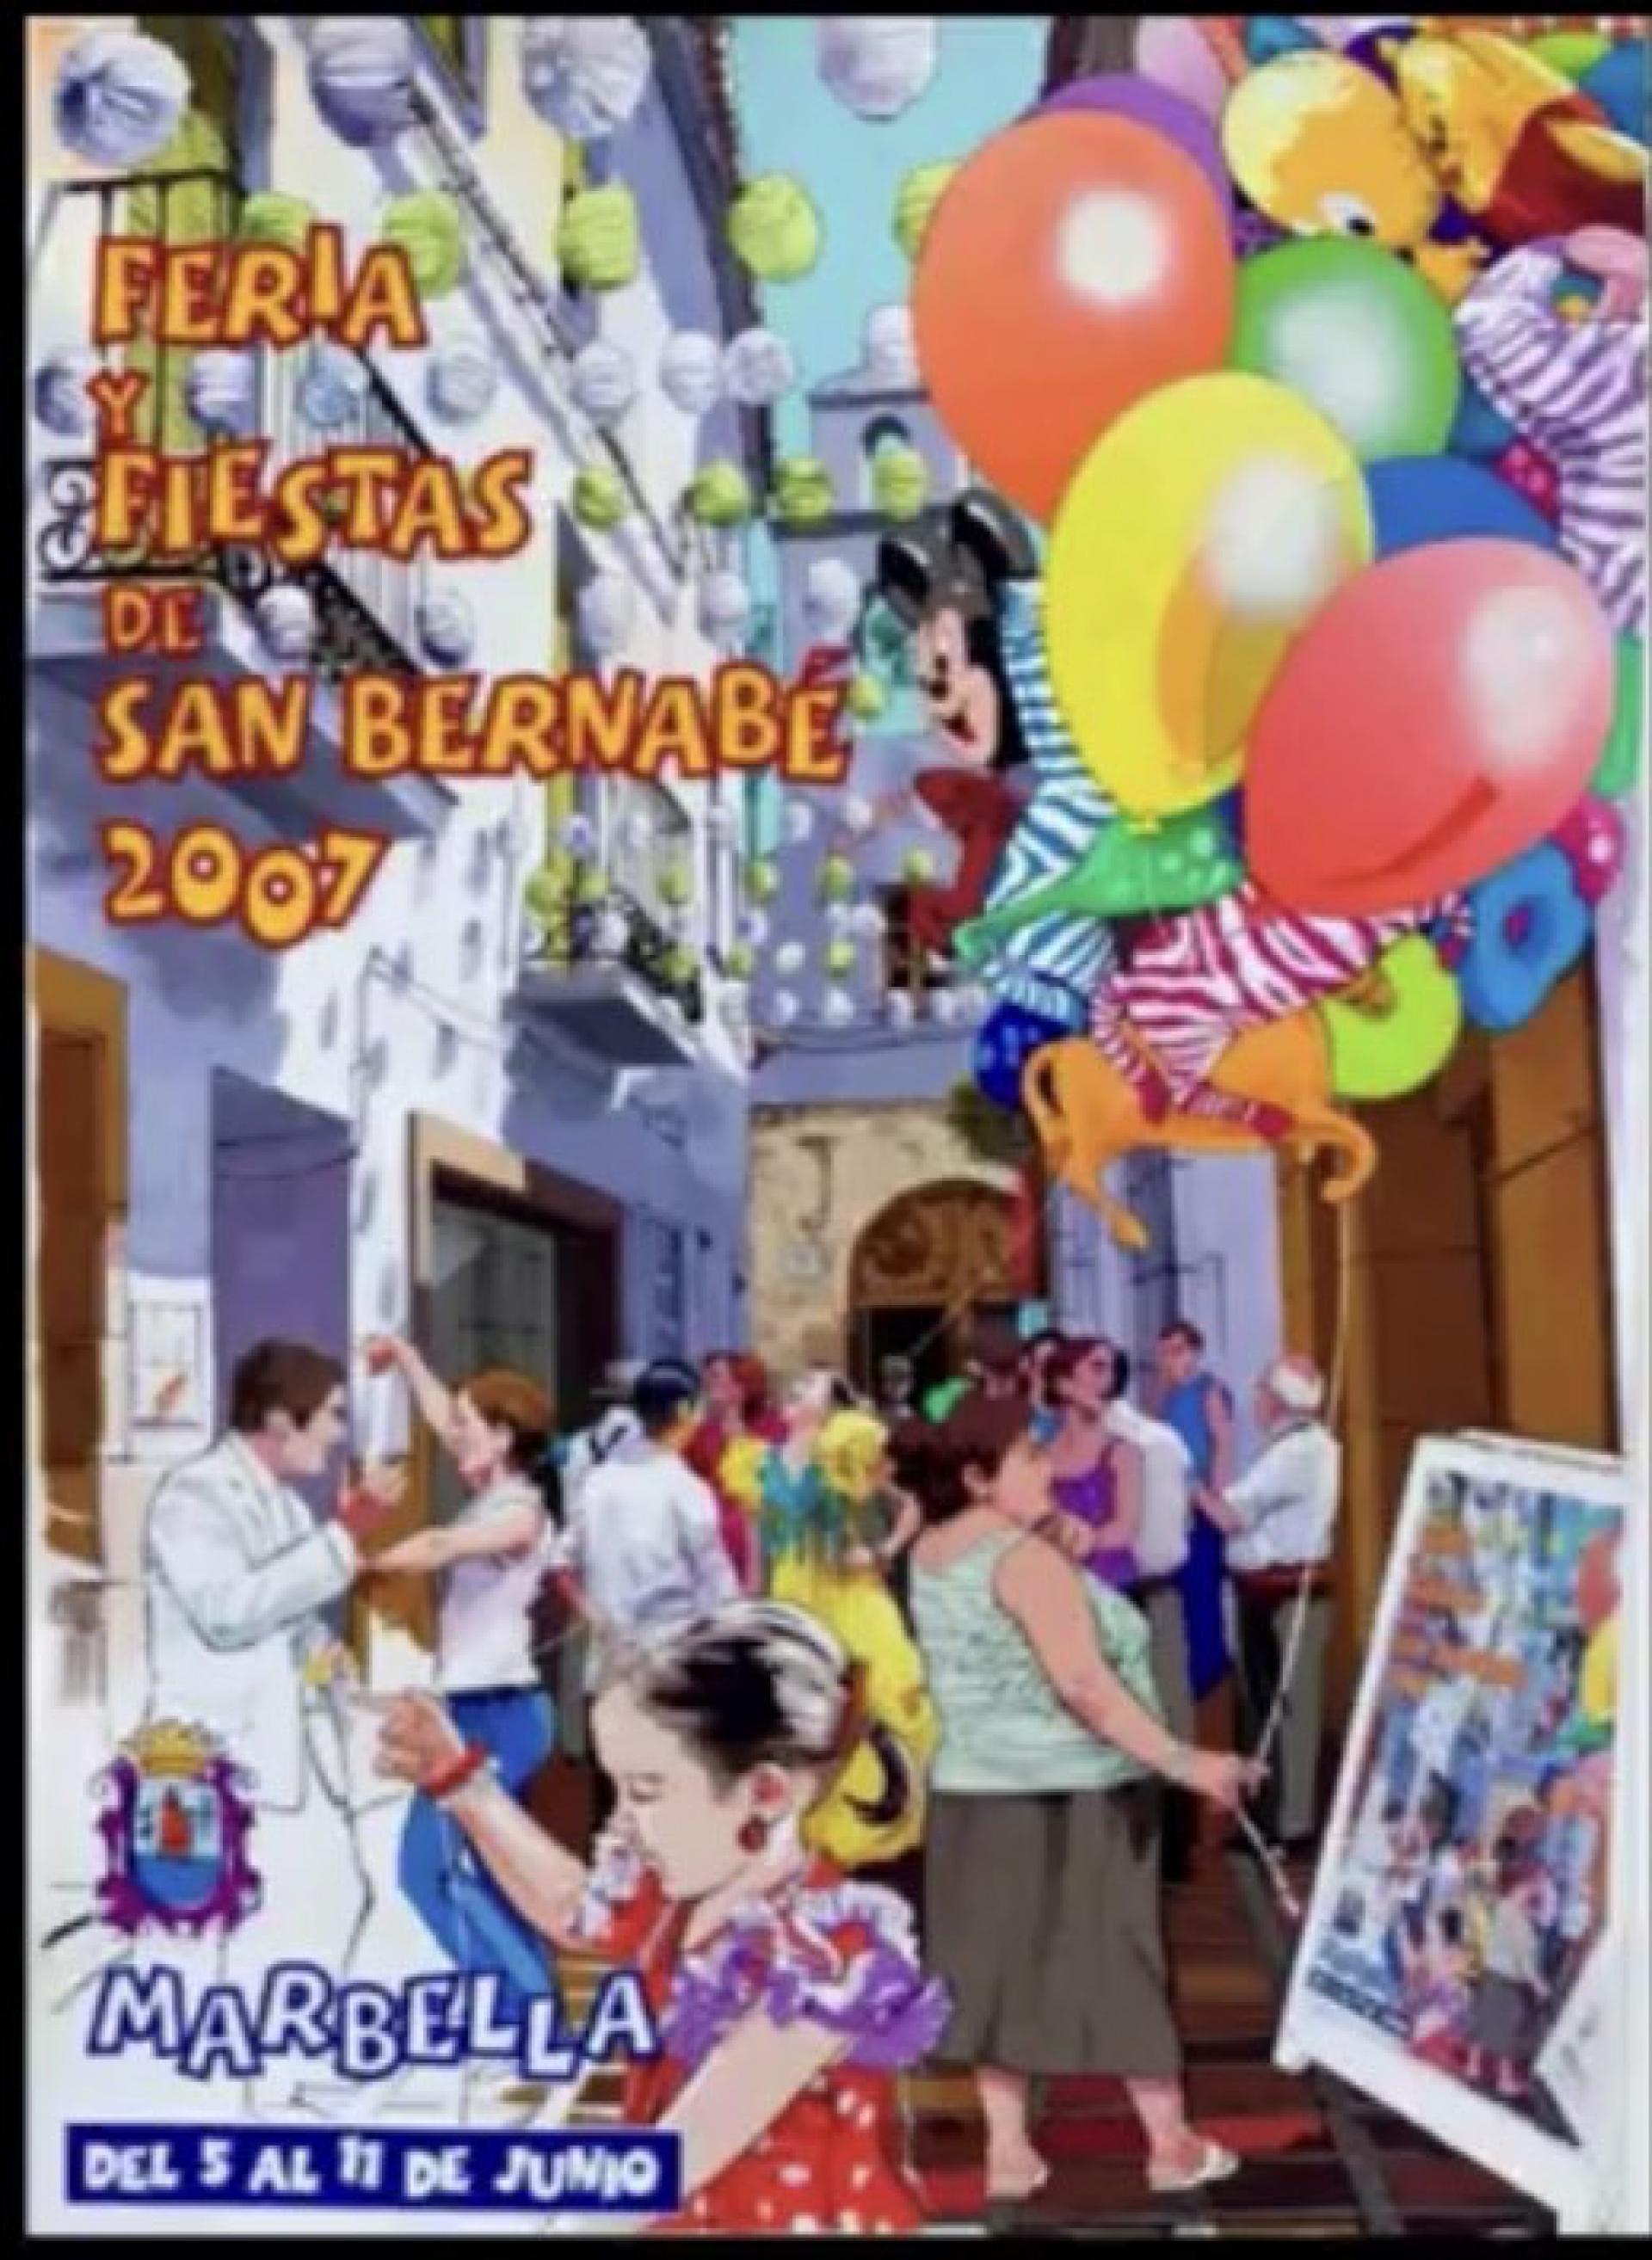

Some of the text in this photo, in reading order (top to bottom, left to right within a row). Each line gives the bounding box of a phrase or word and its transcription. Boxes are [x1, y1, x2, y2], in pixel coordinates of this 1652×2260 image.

[93, 222, 428, 351] FERIA
[86, 370, 151, 445] Y
[95, 440, 534, 563] FIESTAS
[102, 581, 206, 654] DE
[95, 646, 853, 784] SAN BERNABÉ
[100, 822, 391, 952] 2007
[87, 1960, 663, 2082] MARBELLA
[83, 2140, 180, 2193] DEL
[199, 2137, 233, 2187] 5
[248, 2146, 321, 2195] AL
[403, 2146, 470, 2199] DE
[494, 2146, 661, 2201] JUNIO
